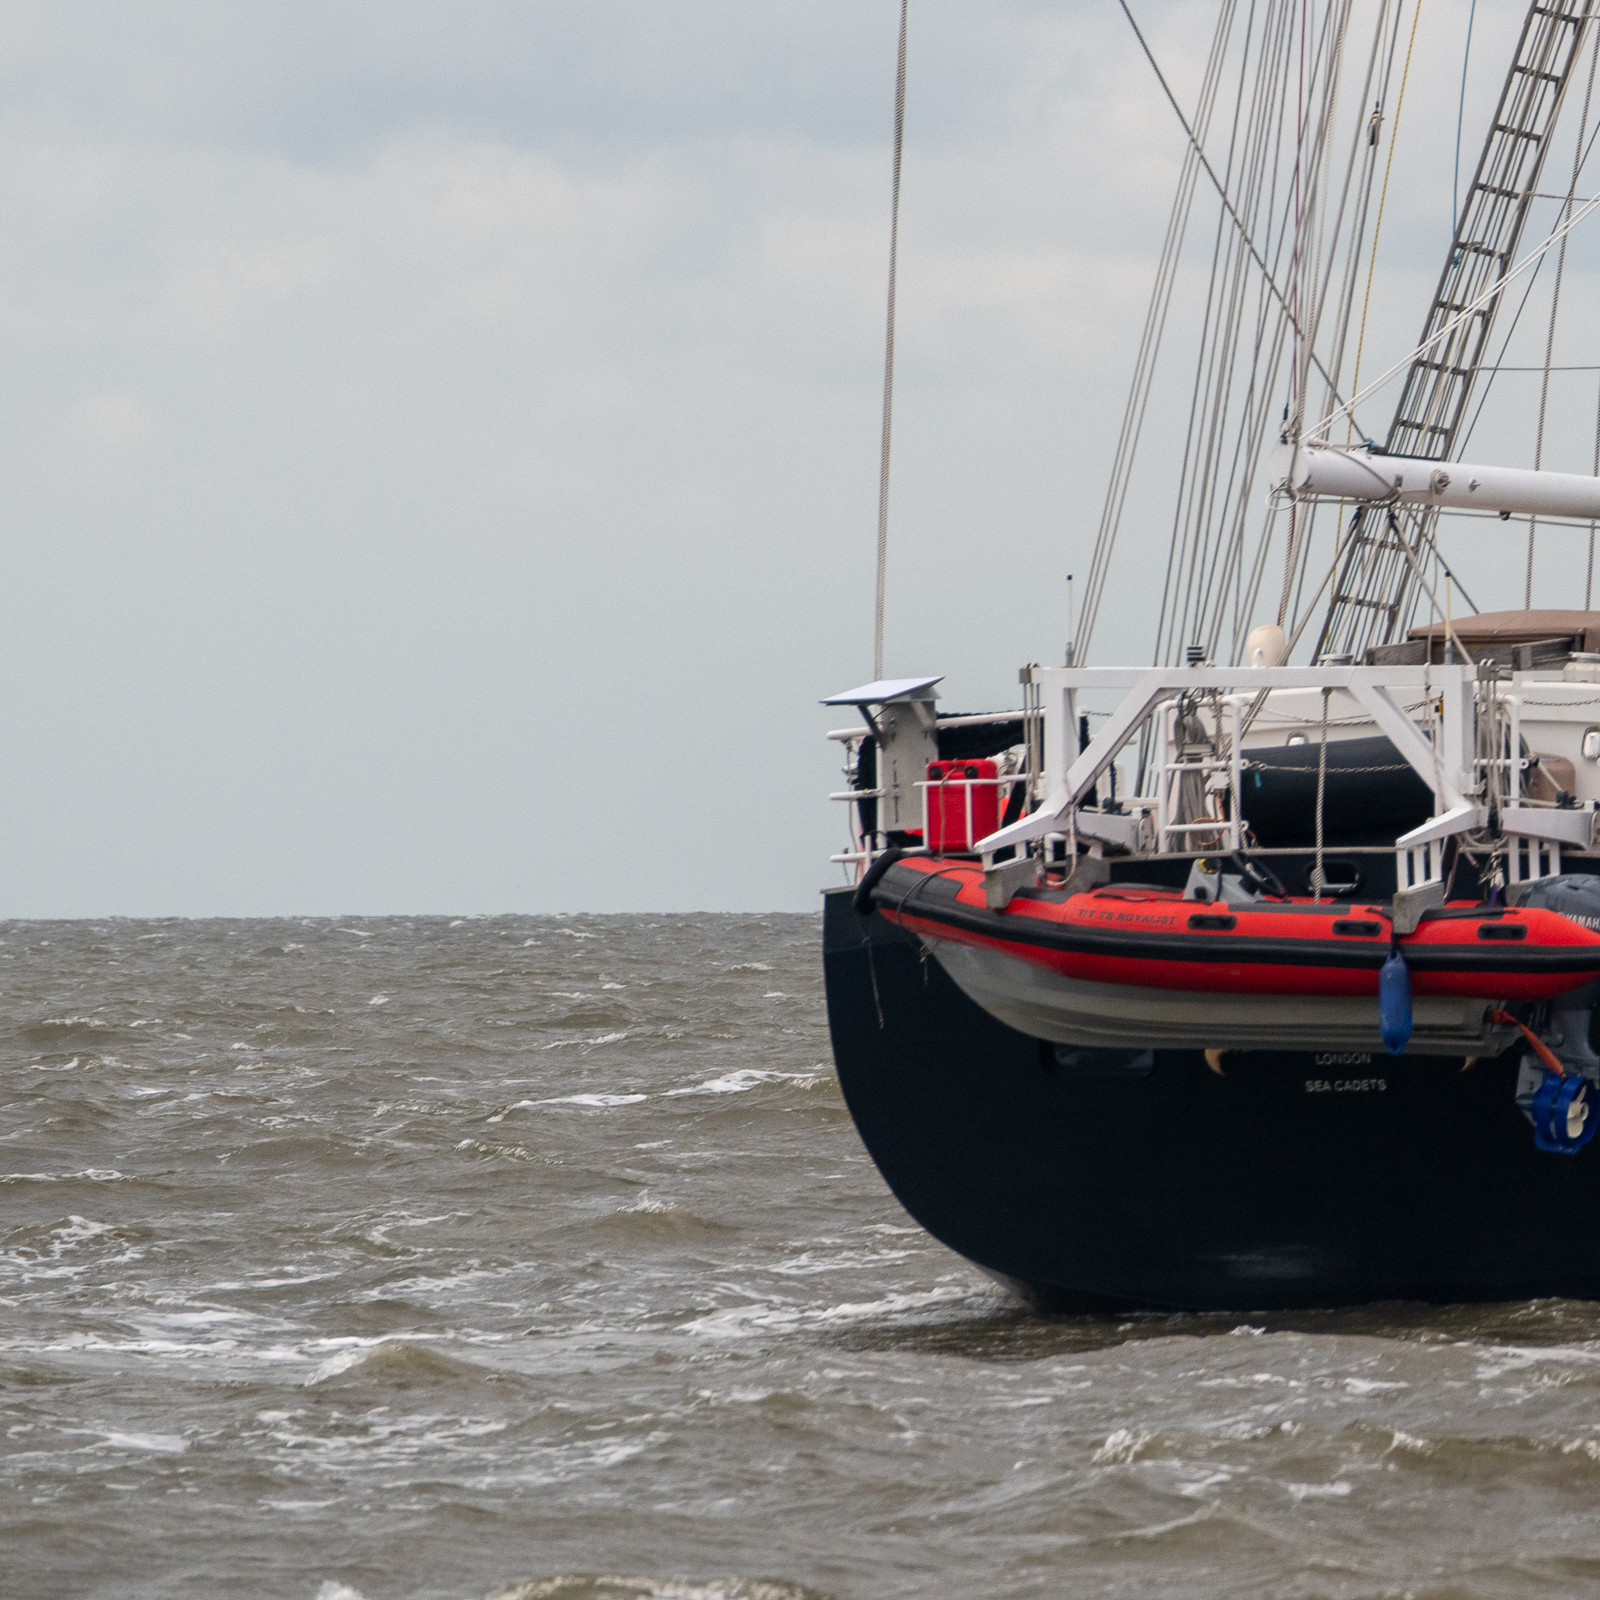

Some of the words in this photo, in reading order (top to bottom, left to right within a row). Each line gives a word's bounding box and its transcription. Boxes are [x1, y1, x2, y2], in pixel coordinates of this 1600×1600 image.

[1116, 913, 1177, 925] ROYALIST
[1315, 1053, 1372, 1065] LONDON
[1305, 1080, 1332, 1092] SEA
[1334, 1079, 1387, 1092] CADETS
